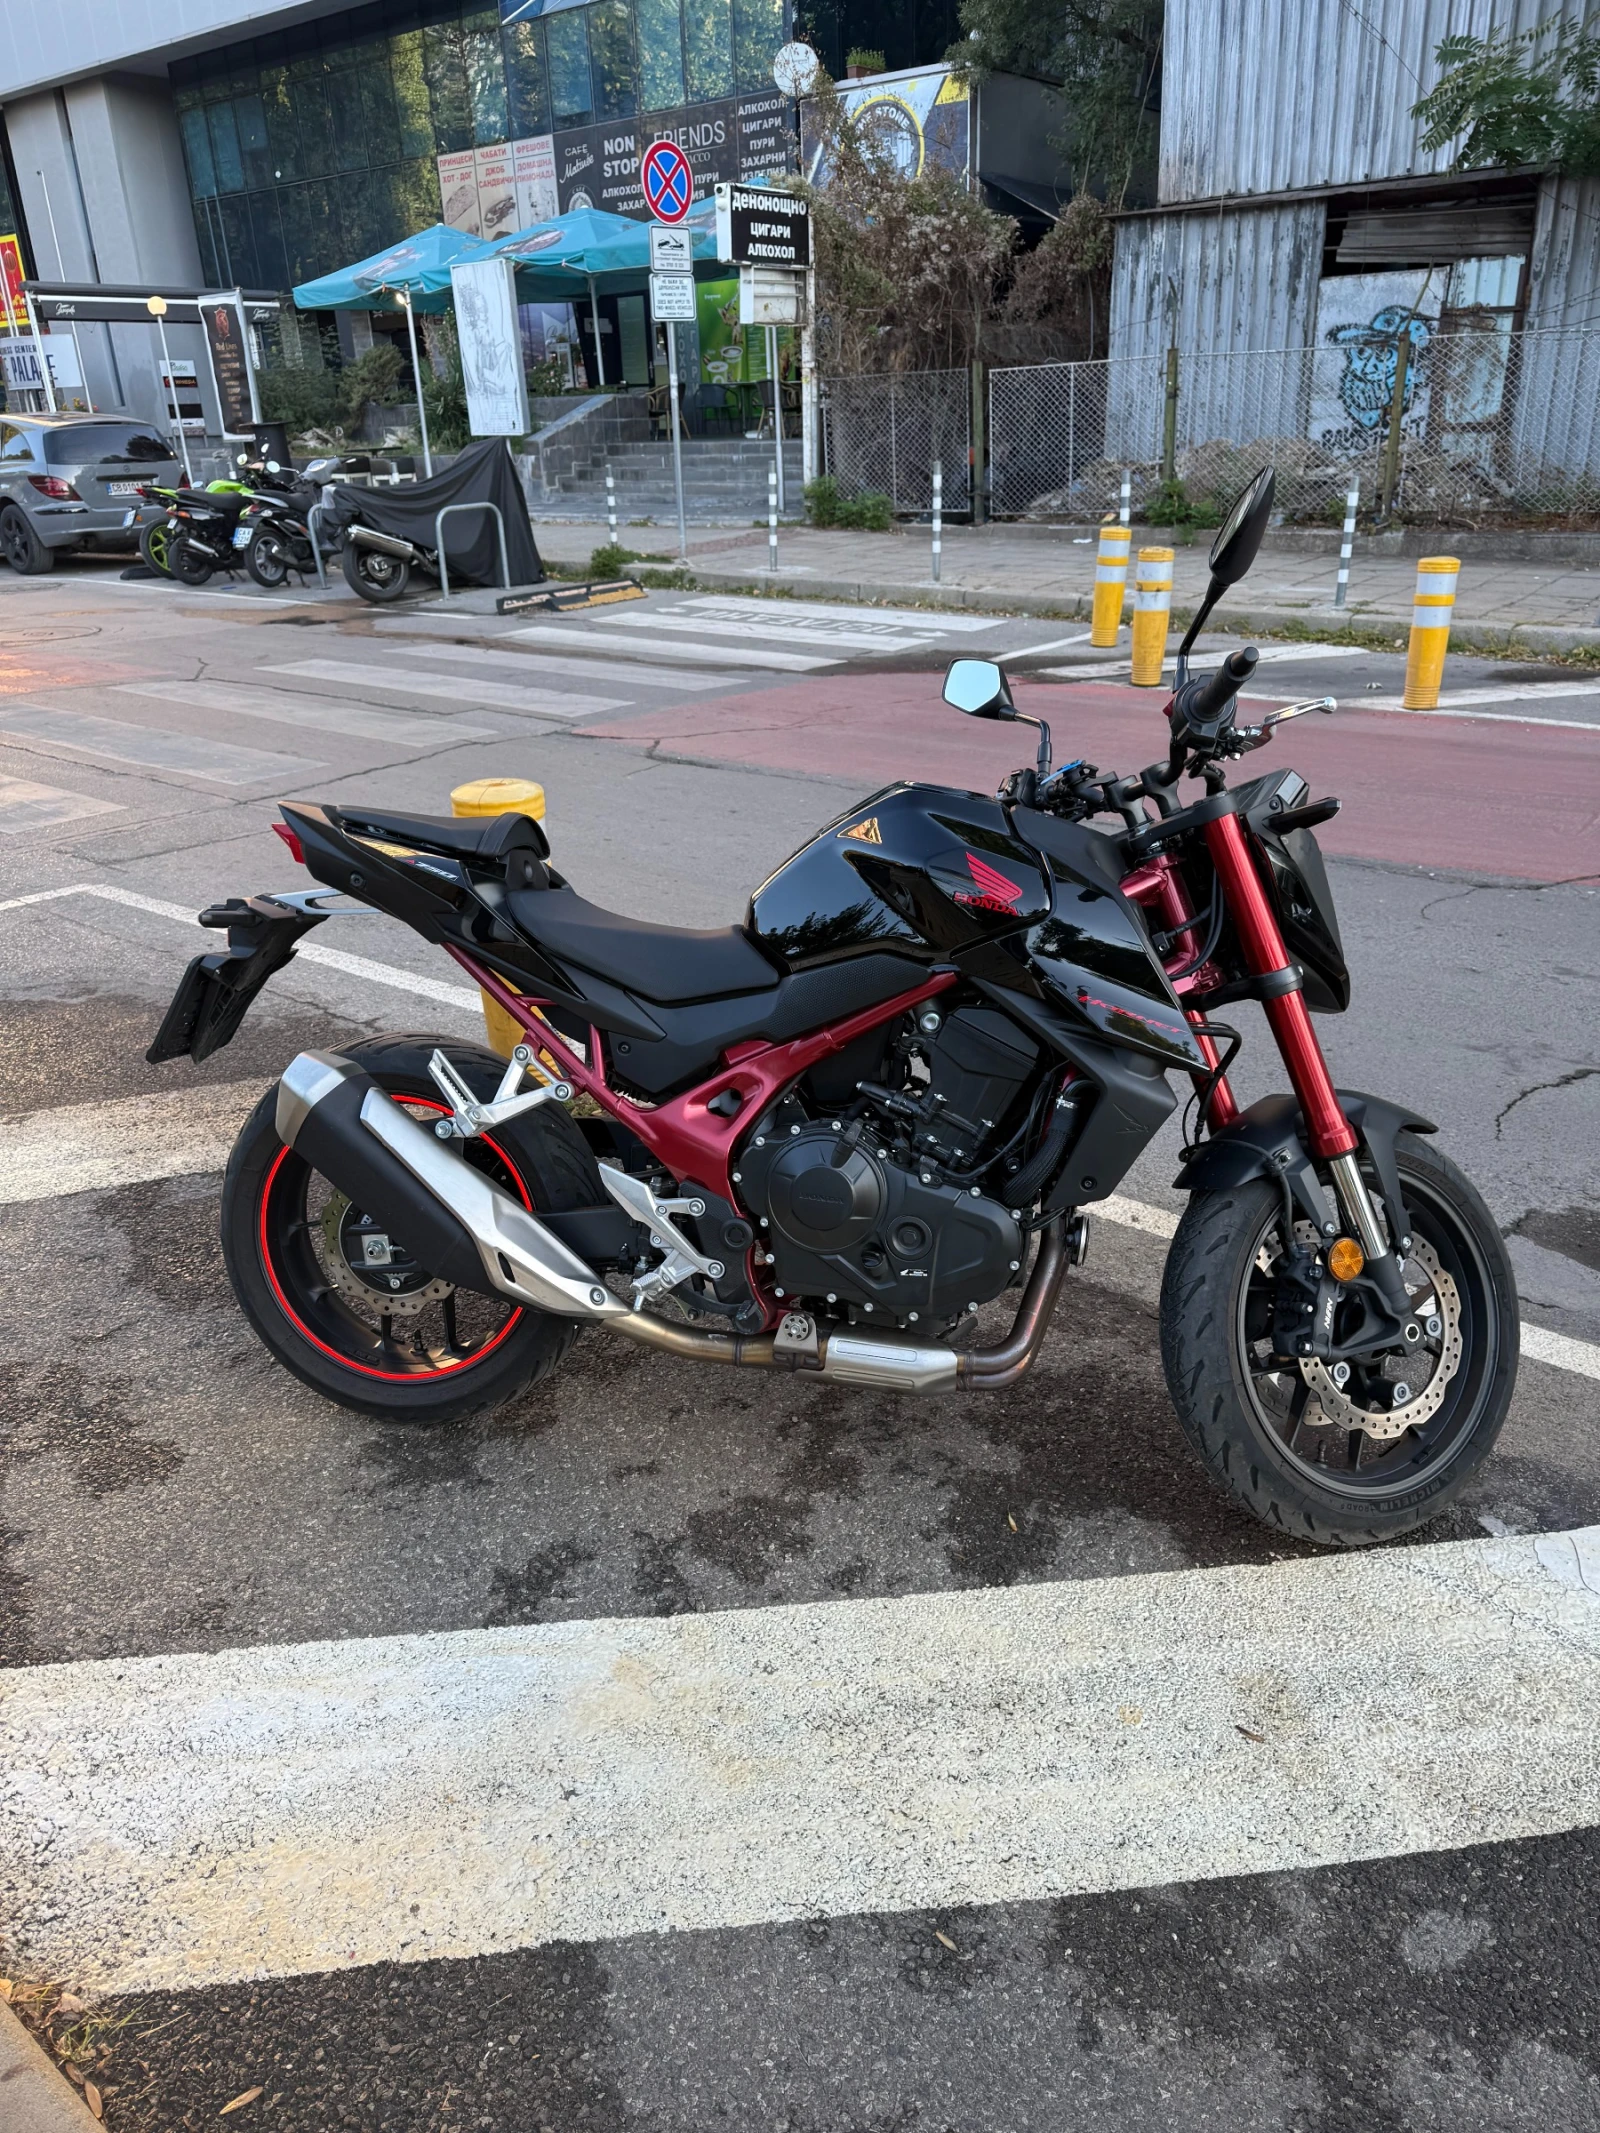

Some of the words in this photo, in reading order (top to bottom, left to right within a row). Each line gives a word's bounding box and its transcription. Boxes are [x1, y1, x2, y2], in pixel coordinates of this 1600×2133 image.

[738, 99, 785, 116] АЛКОХОЛ
[742, 116, 782, 134] ЦИГАРИ
[875, 106, 910, 129] STONE
[516, 141, 550, 153] ФРЕШОВЕ
[604, 135, 635, 156] NON
[750, 137, 775, 151] ПУРИ
[439, 155, 473, 168] ПРИНЦЕСИ
[480, 148, 507, 159] ЧАБАТИ
[741, 151, 786, 168] ЗАХАРНИ
[485, 165, 505, 177] ДЖОБ
[517, 158, 553, 172] ДОМАШНА
[603, 157, 640, 178] STOP
[478, 175, 514, 189] САНДВИЧИ
[694, 172, 720, 185] ПУРИ
[617, 200, 650, 212] ЗАХАР
[750, 222, 791, 239] ЦИГАРИ
[747, 243, 796, 259] АЛКОХОЛ
[10, 354, 58, 382] PALAE
[953, 891, 1019, 917] HONDA
[1380, 1480, 1441, 1511] MICHELIN
